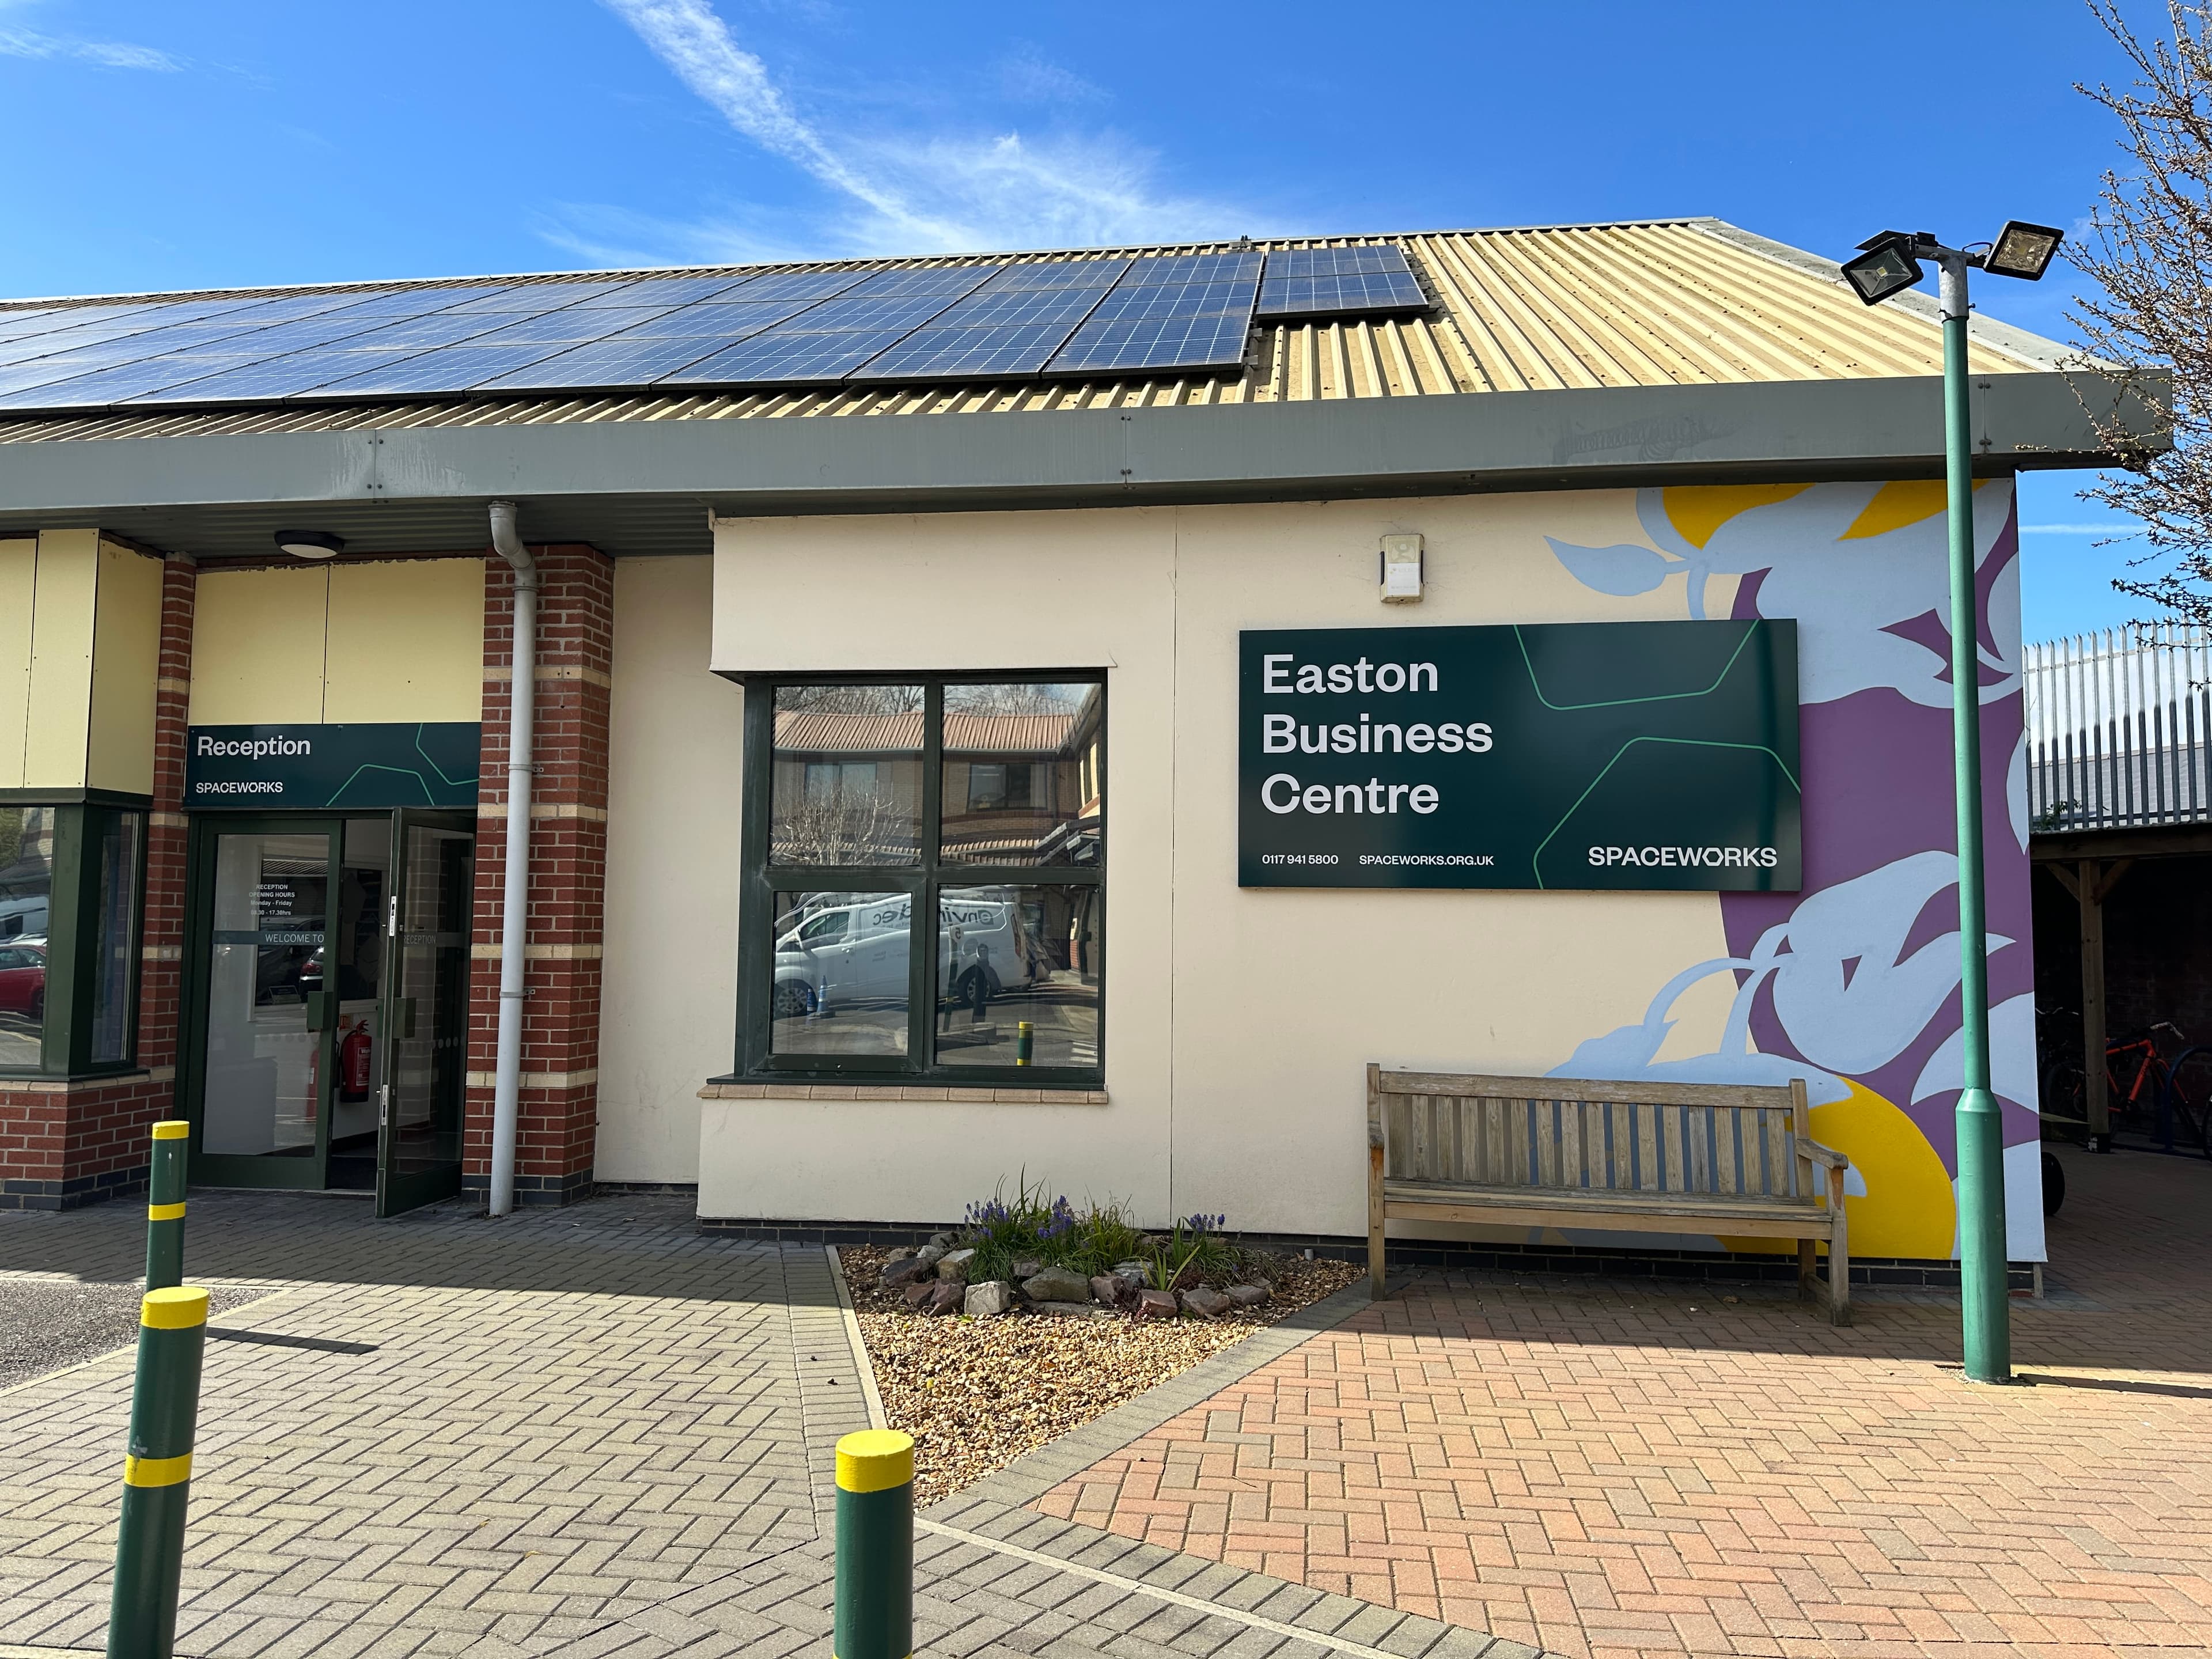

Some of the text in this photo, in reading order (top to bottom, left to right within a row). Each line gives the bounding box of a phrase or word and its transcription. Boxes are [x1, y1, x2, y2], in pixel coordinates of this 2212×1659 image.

[1263, 654, 1438, 694] Easton
[1263, 713, 1493, 753] Business
[197, 735, 311, 760] Reception
[196, 781, 284, 794] SPACEWORKS
[1261, 772, 1440, 815] Centre
[1262, 854, 1339, 865] 0117 941 5800
[1358, 855, 1495, 866] SPACEWORKS.ORG.UK
[1588, 846, 1778, 868] SPACEWORKS
[265, 934, 324, 943] WELCOME TO
